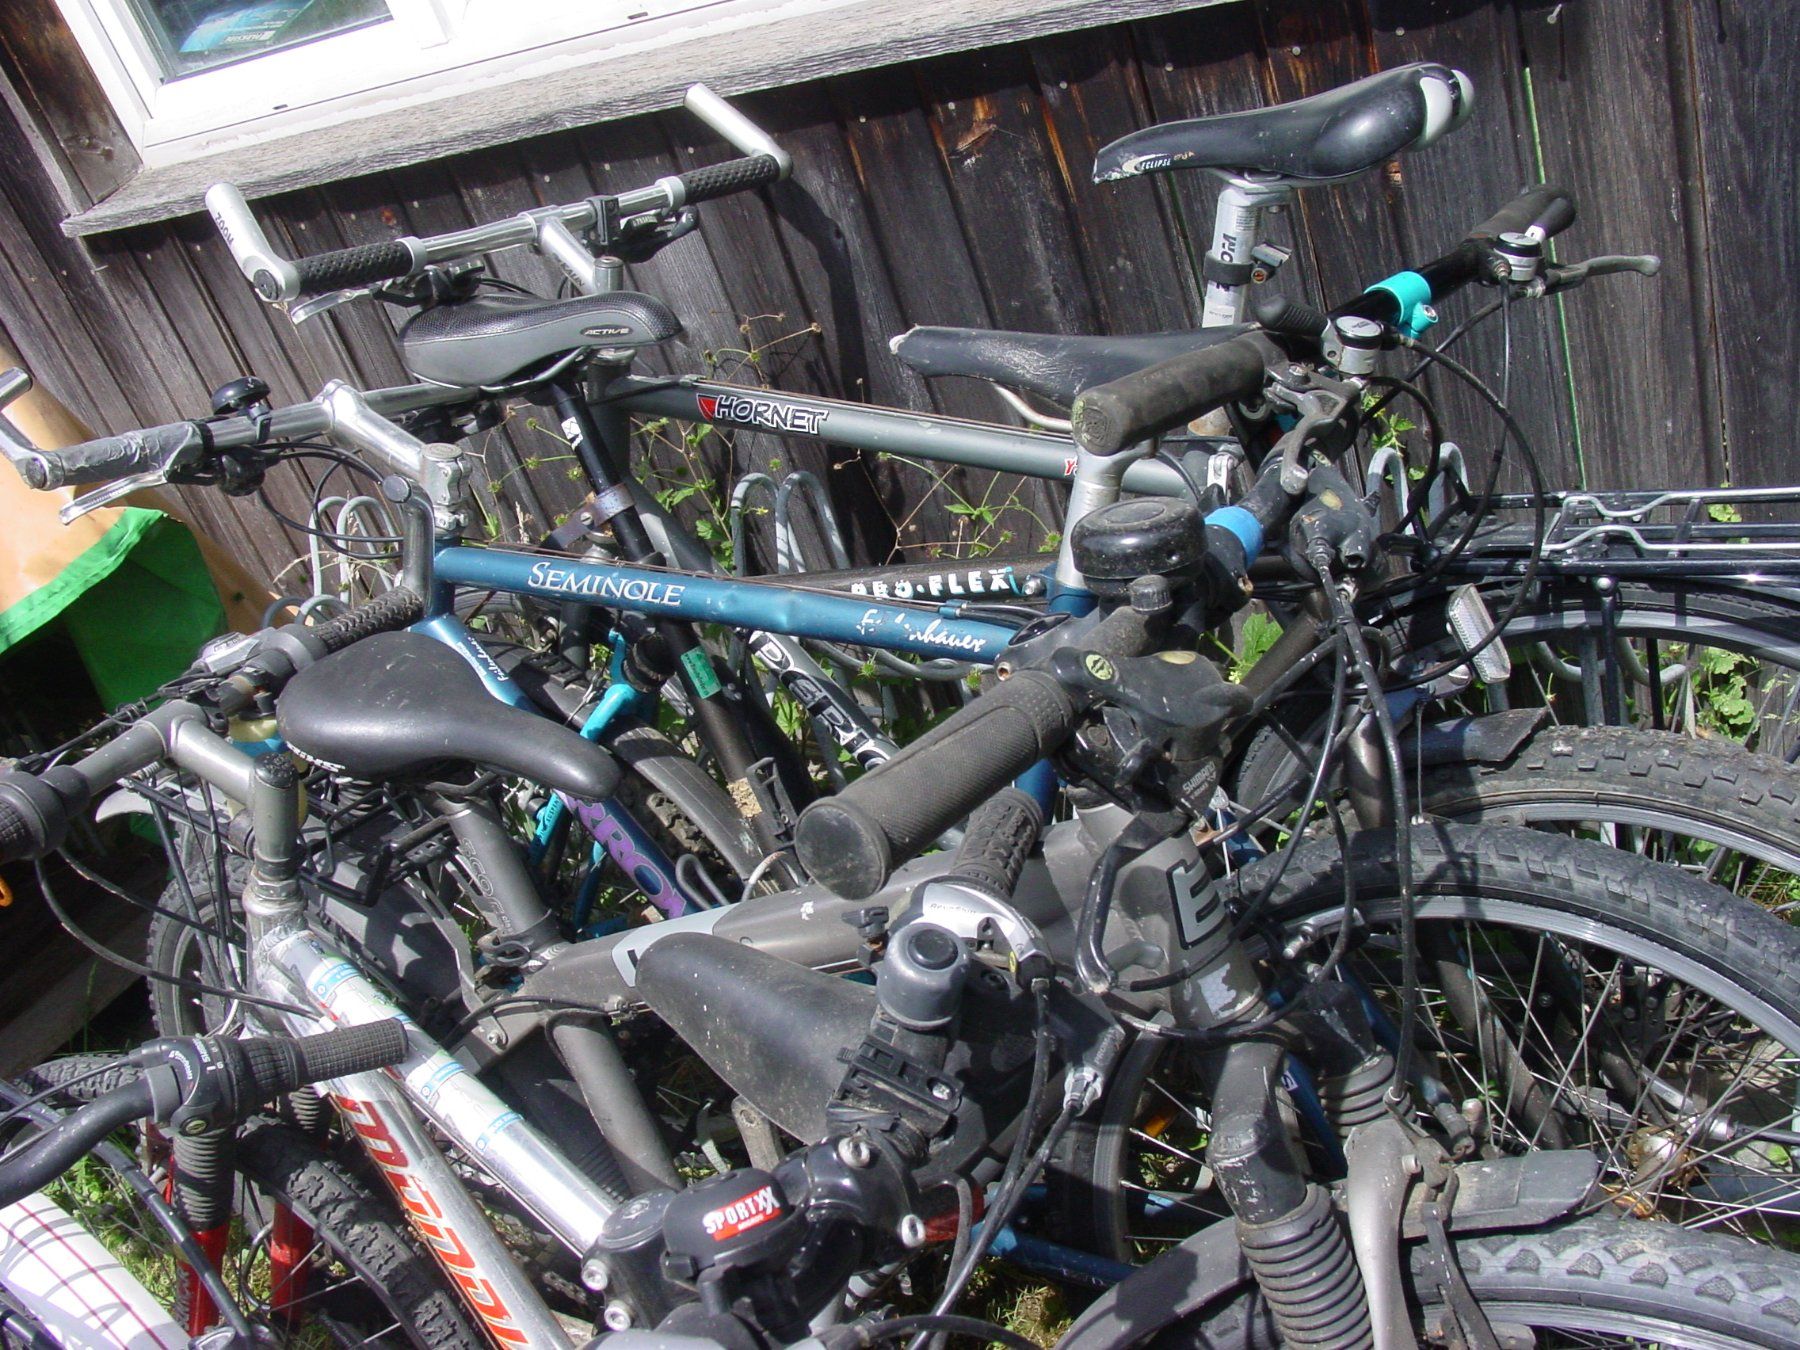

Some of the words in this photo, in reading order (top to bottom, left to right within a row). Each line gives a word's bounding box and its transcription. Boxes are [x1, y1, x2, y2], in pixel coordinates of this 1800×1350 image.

[1141, 158, 1171, 169] ECLIPSE
[716, 394, 829, 434] HORNET
[527, 561, 685, 607] SEMINOLE
[1182, 761, 1216, 794] SHIMANO
[702, 1186, 780, 1235] SPORTXX
